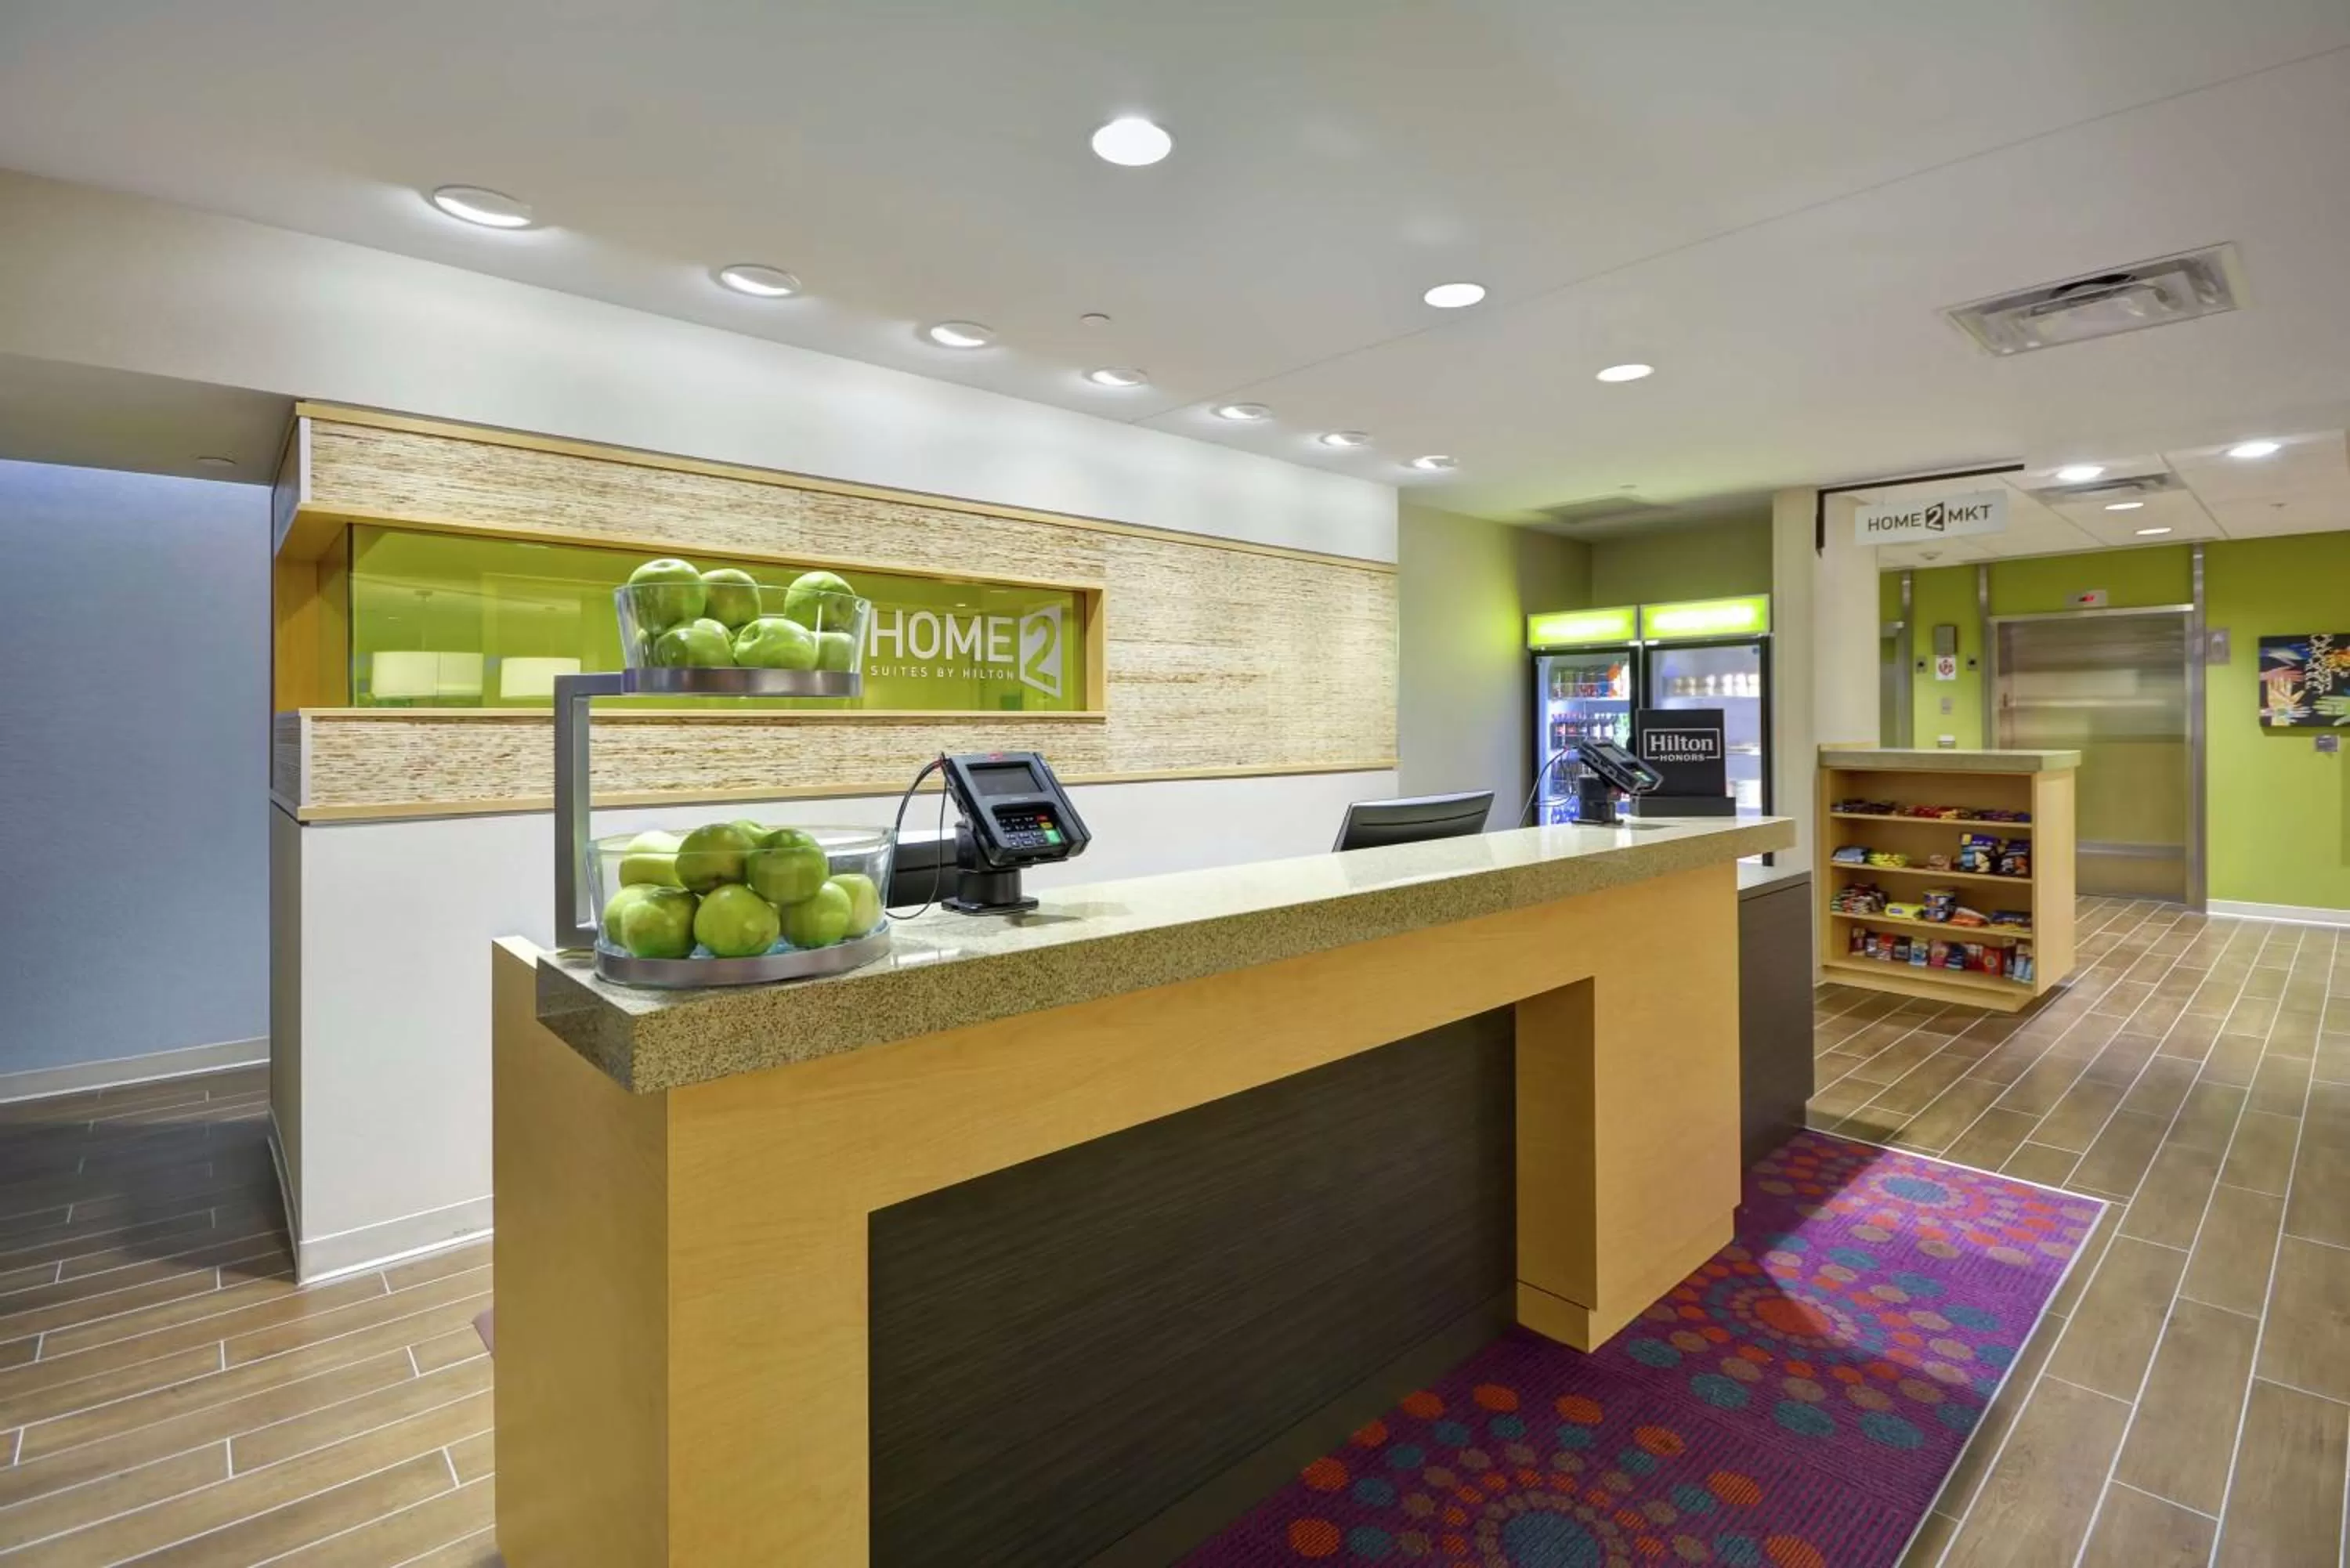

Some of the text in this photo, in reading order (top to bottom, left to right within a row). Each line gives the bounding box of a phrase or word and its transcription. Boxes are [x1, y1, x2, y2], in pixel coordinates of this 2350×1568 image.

[1867, 501, 1994, 533] HOME 2 MKT
[870, 608, 1015, 663] HOME
[870, 665, 1014, 681] SUITES BY HILTON
[1650, 734, 1714, 752] Hilton
[1659, 753, 1705, 763] HONORS
